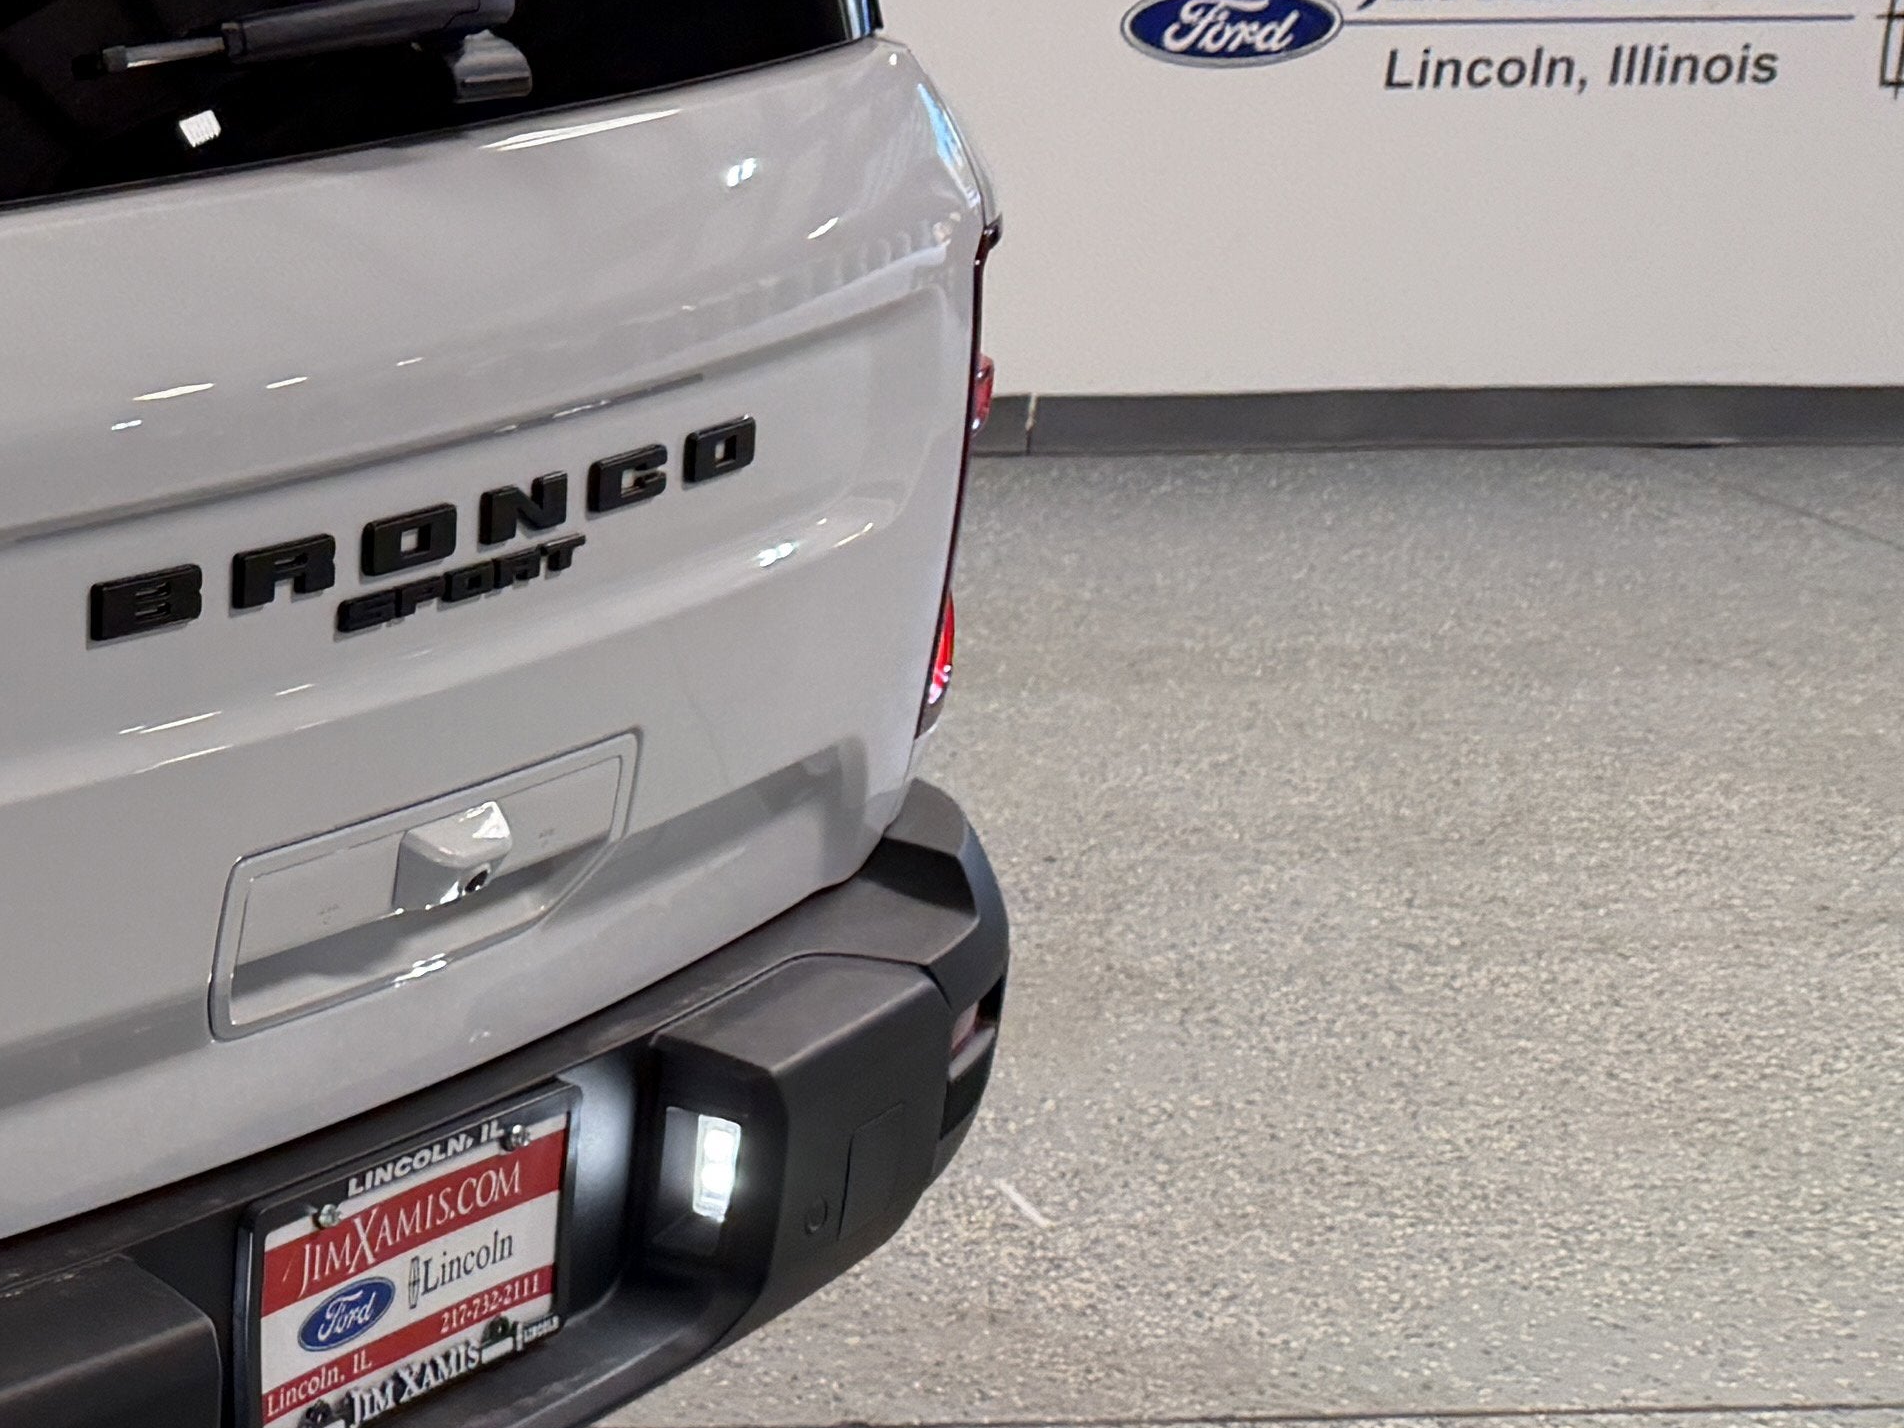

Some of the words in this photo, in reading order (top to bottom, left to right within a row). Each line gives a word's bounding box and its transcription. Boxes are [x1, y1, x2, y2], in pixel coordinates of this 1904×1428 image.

[1384, 46, 1589, 94] Lincoln,
[1608, 43, 1779, 86] Illinois
[88, 415, 757, 642] BRONCO
[336, 532, 587, 633] SPORT
[346, 1132, 475, 1198] LINCOLN,
[480, 1119, 505, 1145] IL
[420, 1229, 514, 1296] Lincoln
[317, 1288, 378, 1342] Ford
[439, 1272, 541, 1335] 217-732-2111
[266, 1359, 347, 1417] Lincoln,
[352, 1350, 374, 1372] IL
[397, 1340, 481, 1404] XAMIS
